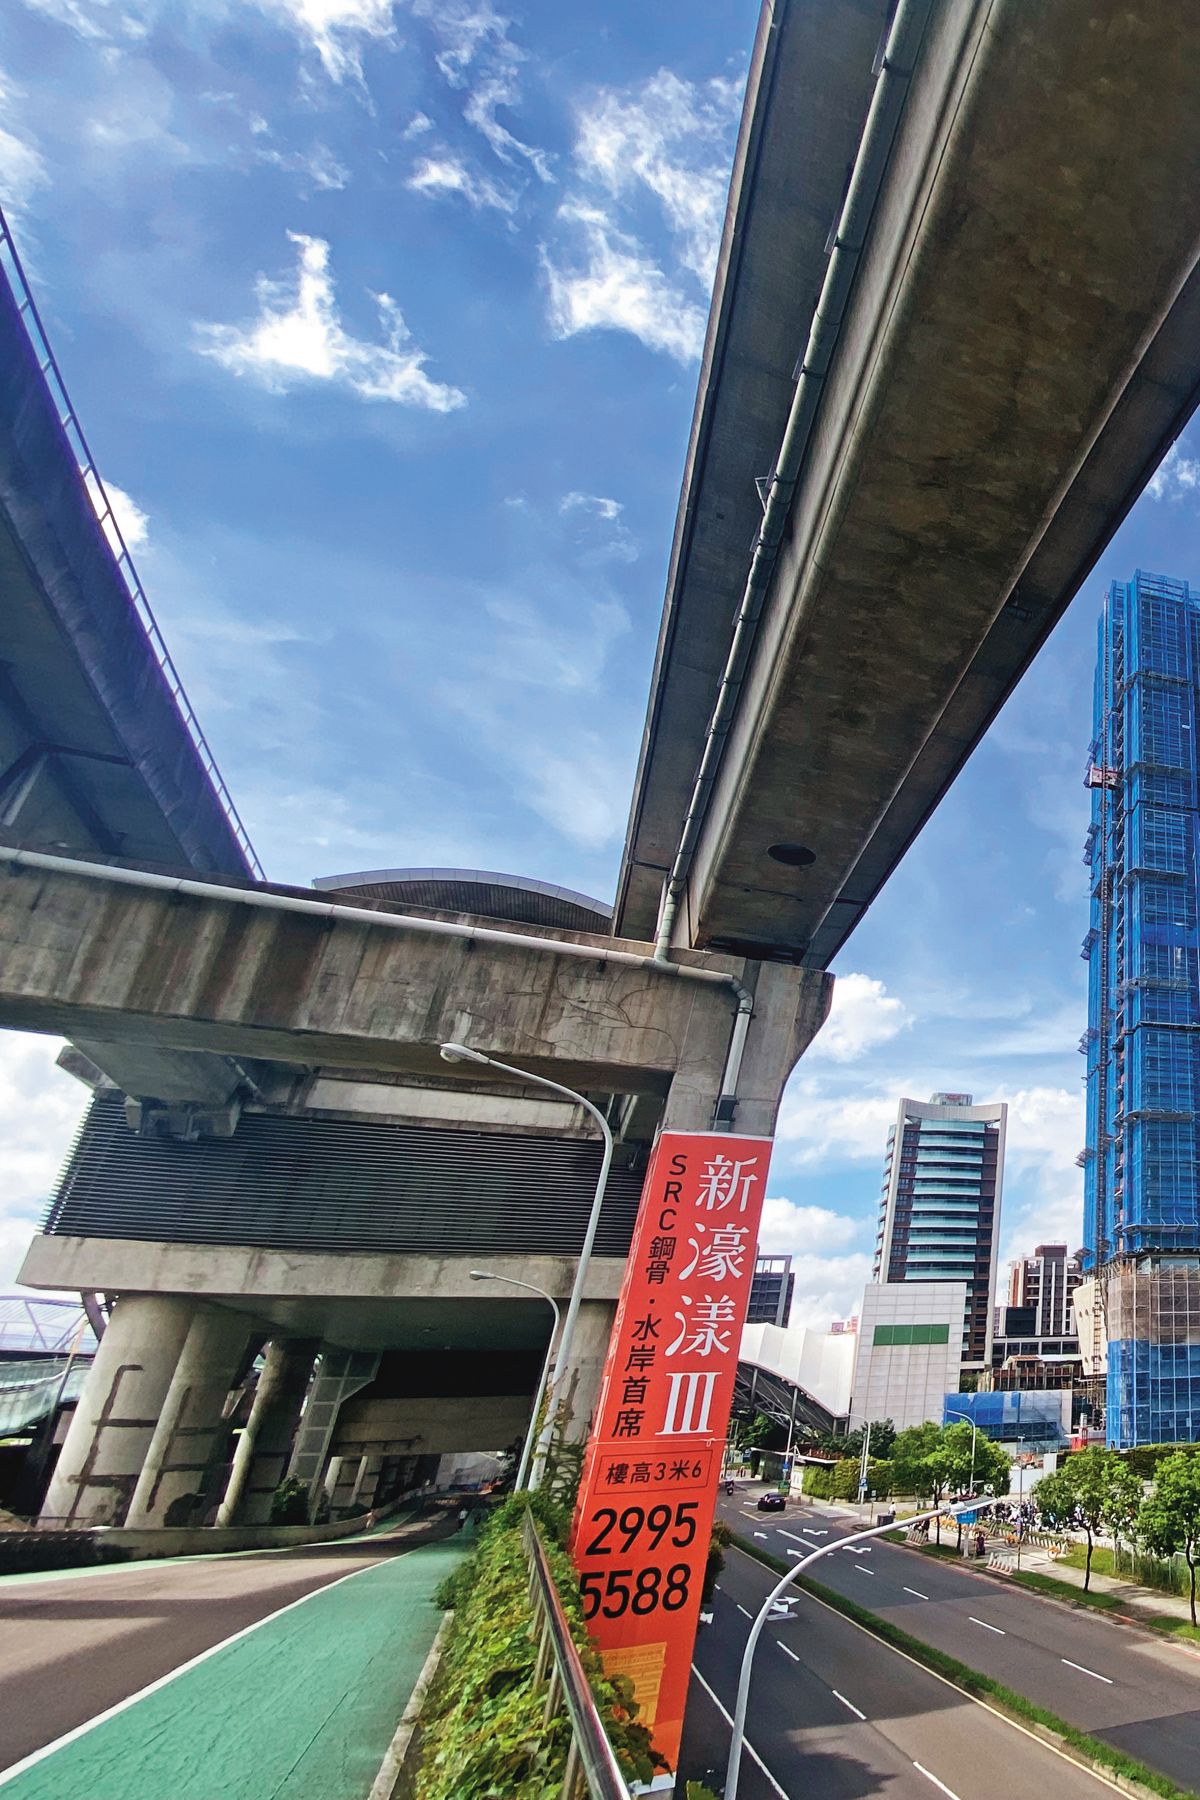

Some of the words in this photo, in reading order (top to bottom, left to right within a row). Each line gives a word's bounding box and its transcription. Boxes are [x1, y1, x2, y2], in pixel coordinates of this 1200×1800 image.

[605, 1459, 702, 1485] 樓高3米6
[585, 1502, 699, 1556] 2995
[580, 1563, 691, 1620] 5588
